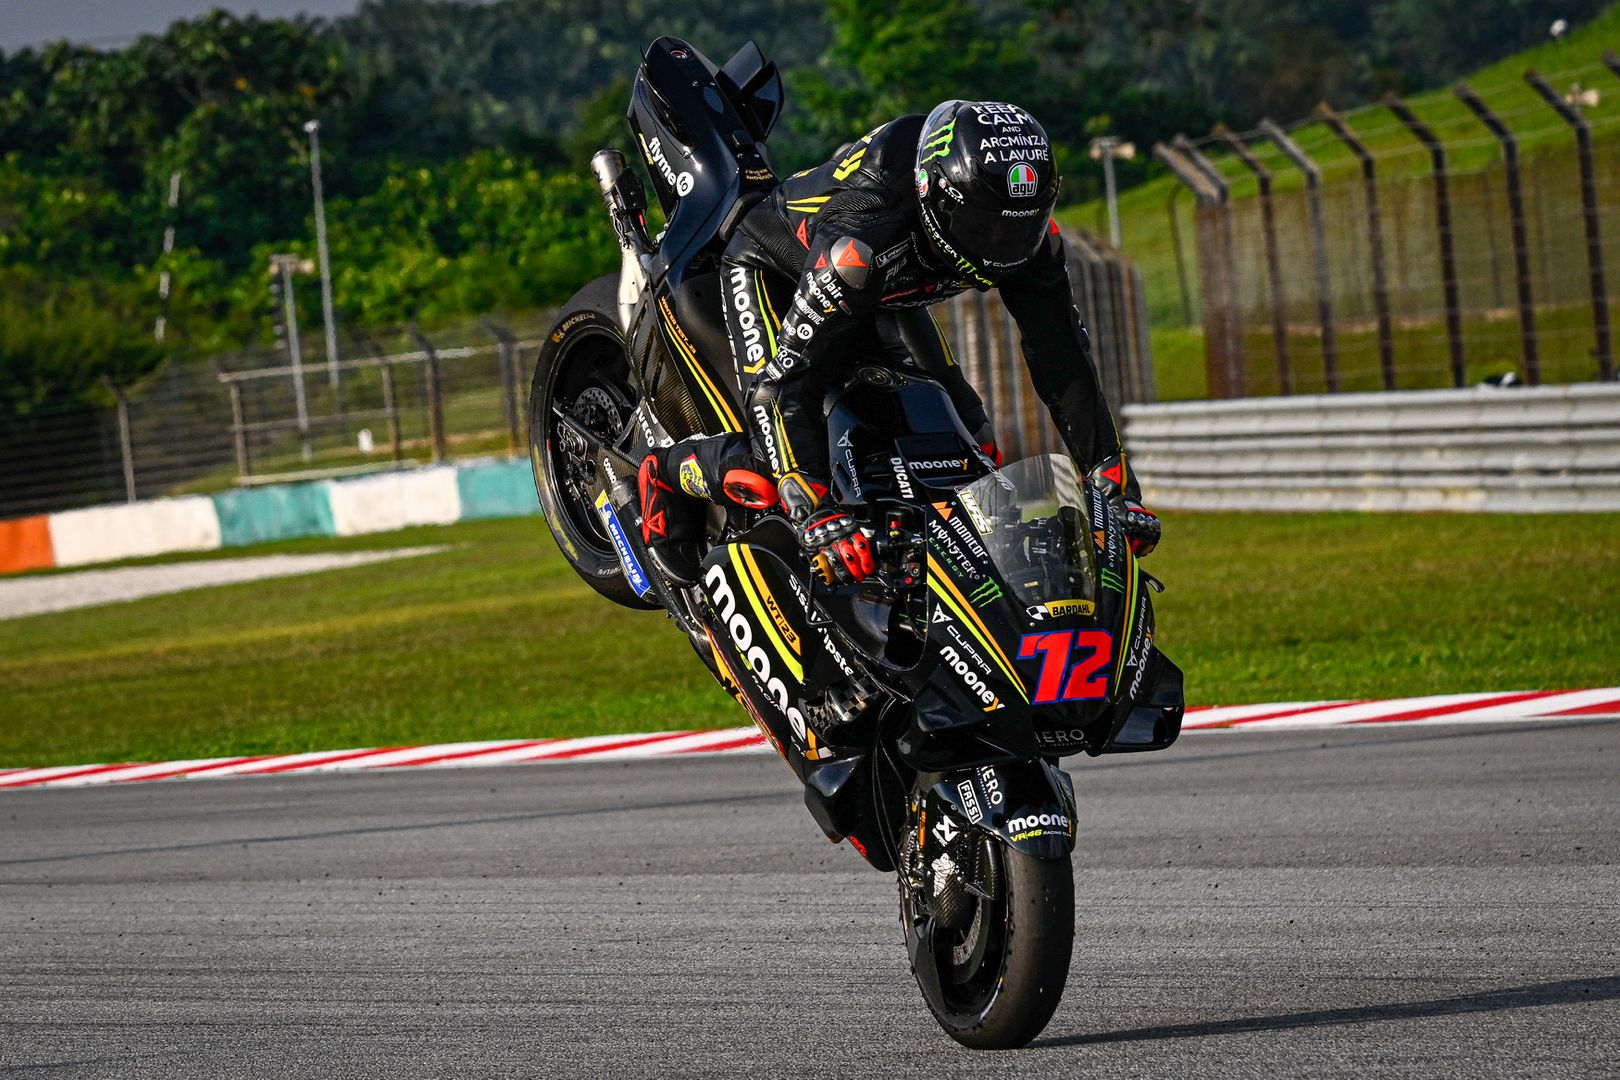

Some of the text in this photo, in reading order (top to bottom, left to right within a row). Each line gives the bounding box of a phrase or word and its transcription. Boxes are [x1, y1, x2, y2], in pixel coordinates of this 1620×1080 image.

[977, 112, 1033, 126] CALM
[984, 152, 997, 164] A
[1013, 183, 1033, 195] agv
[1002, 208, 1040, 218] mooney
[806, 271, 837, 314] mooney
[730, 267, 766, 374] mooney
[635, 406, 655, 448] IVECO
[845, 449, 862, 498] CUPRA
[890, 456, 915, 499] DUCATI
[909, 458, 968, 471] mooney
[609, 523, 643, 588] MICHELIN
[929, 537, 965, 578] ENERGY
[1053, 601, 1091, 615] BARDAHL
[1135, 596, 1148, 651] CUPRA
[705, 564, 834, 761] mooney
[946, 624, 992, 676] CUPRA
[1016, 628, 1114, 705] 72
[1129, 627, 1154, 701] mooney
[940, 645, 1006, 713] mooney
[961, 783, 981, 823] FASSI
